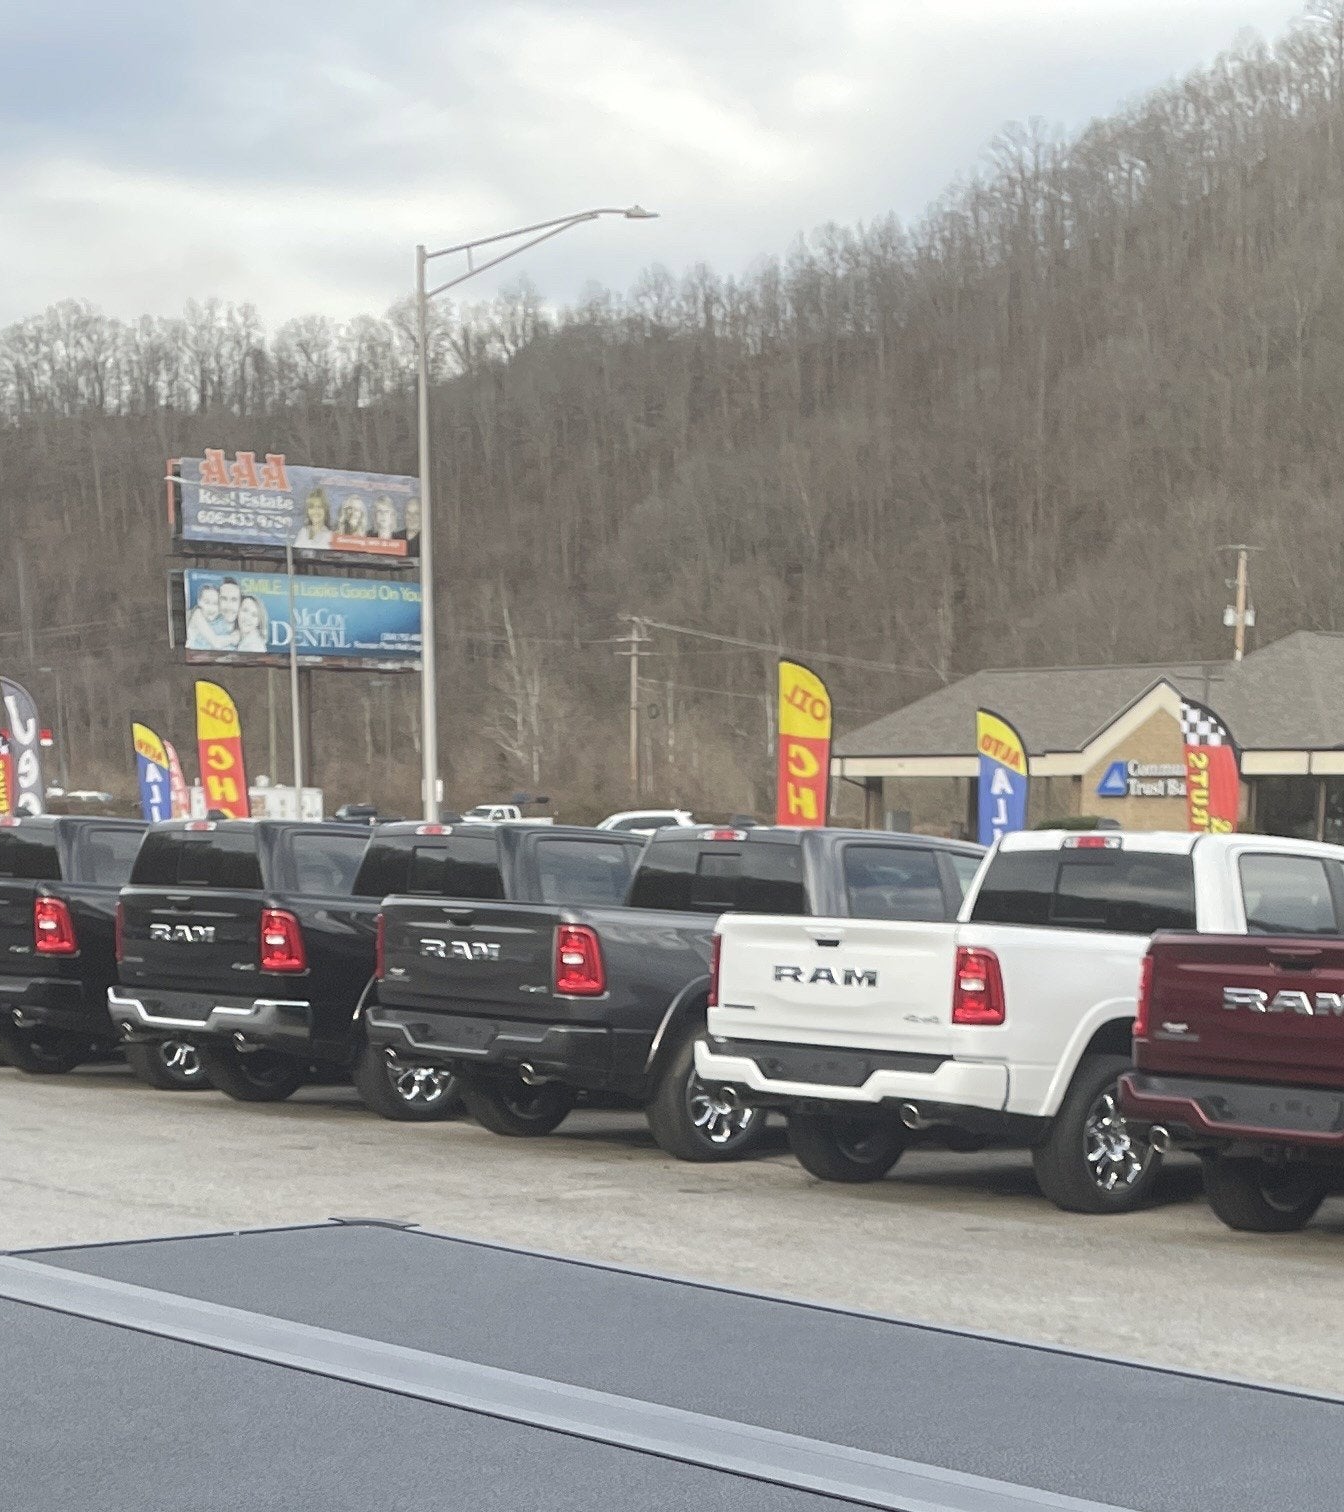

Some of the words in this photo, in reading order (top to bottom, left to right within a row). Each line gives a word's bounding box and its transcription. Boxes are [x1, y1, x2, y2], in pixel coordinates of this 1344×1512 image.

[199, 448, 292, 492] AAA
[271, 620, 353, 649] DENTAL
[1126, 777, 1165, 796] Trust
[149, 924, 216, 943] RAM
[419, 938, 502, 961] RAM
[773, 964, 879, 988] RAM
